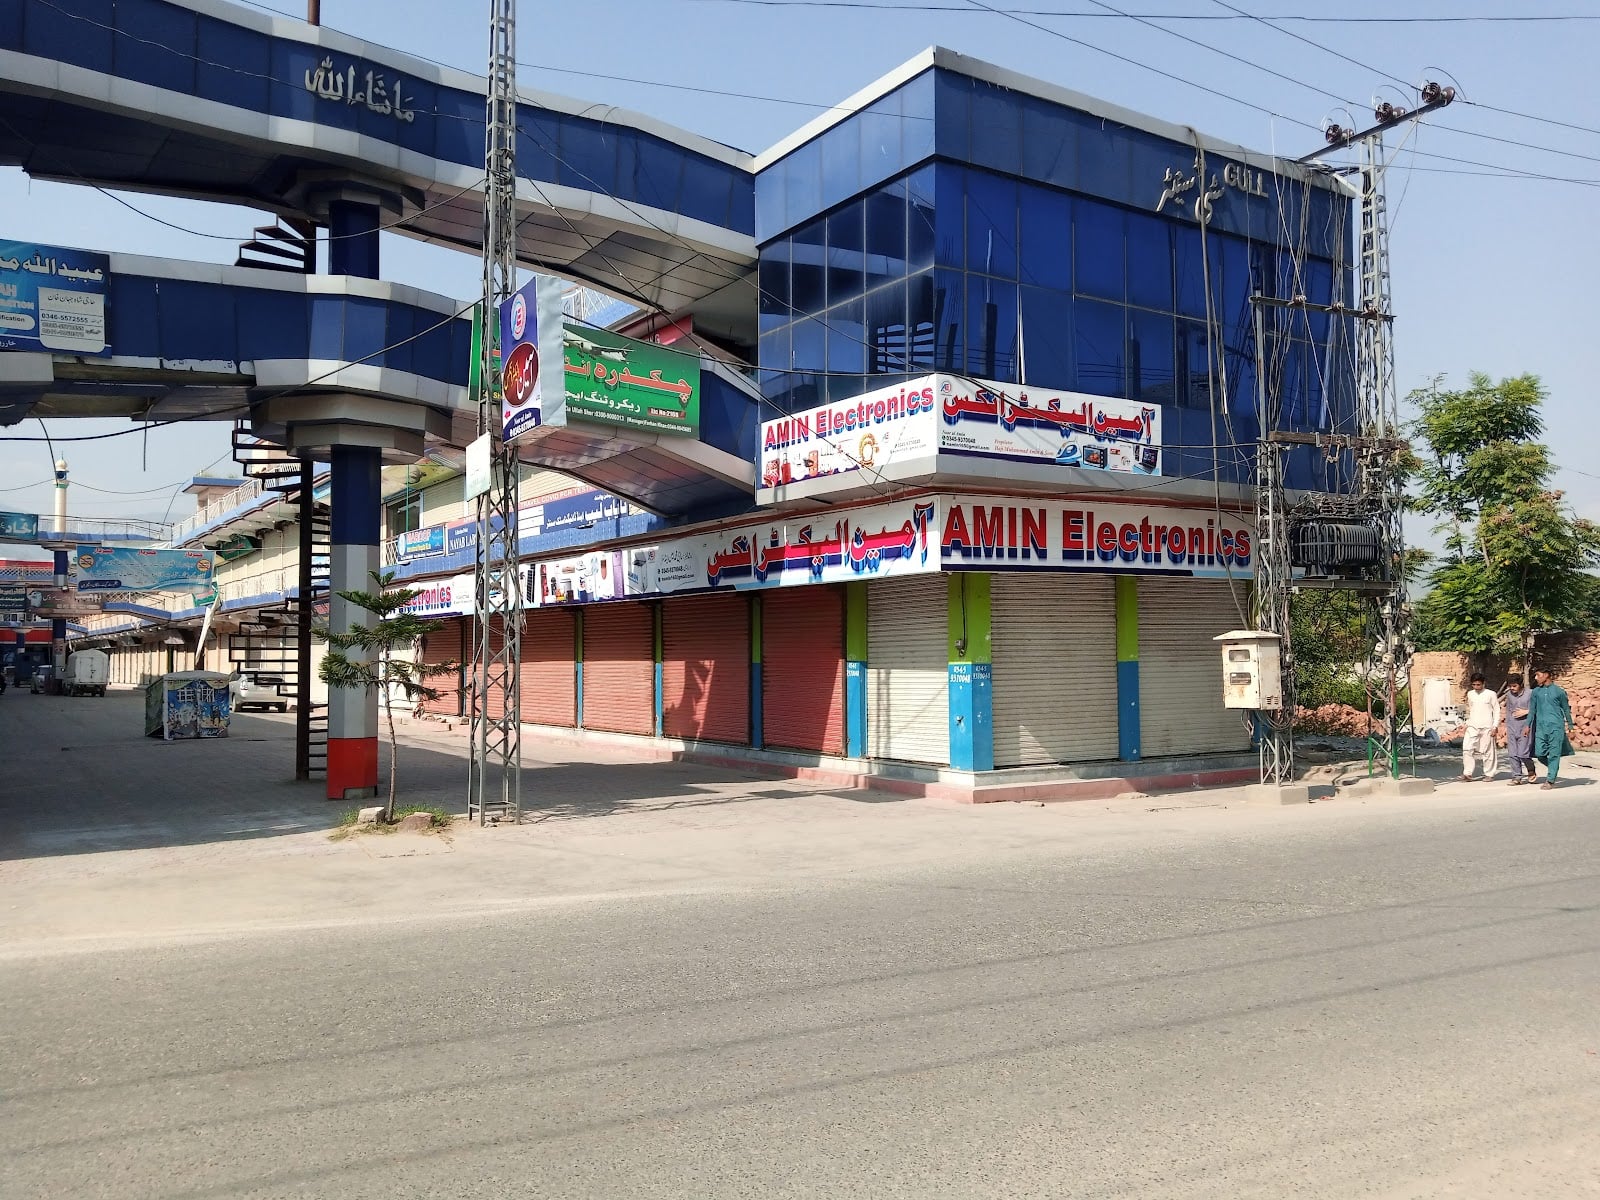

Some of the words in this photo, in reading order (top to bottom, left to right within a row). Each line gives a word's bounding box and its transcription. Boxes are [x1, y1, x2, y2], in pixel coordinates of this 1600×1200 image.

[1224, 162, 1269, 198] GULL
[22, 249, 56, 276] الله
[58, 262, 104, 284] عبید
[594, 361, 693, 403] چکدرہ
[764, 415, 810, 452] AMIN
[815, 387, 934, 439] Electronics
[1094, 405, 1156, 444] آمین
[542, 492, 560, 503] COVID
[851, 502, 934, 572] آمین
[941, 504, 1047, 558] AMIN
[1062, 509, 1252, 566] Electronics
